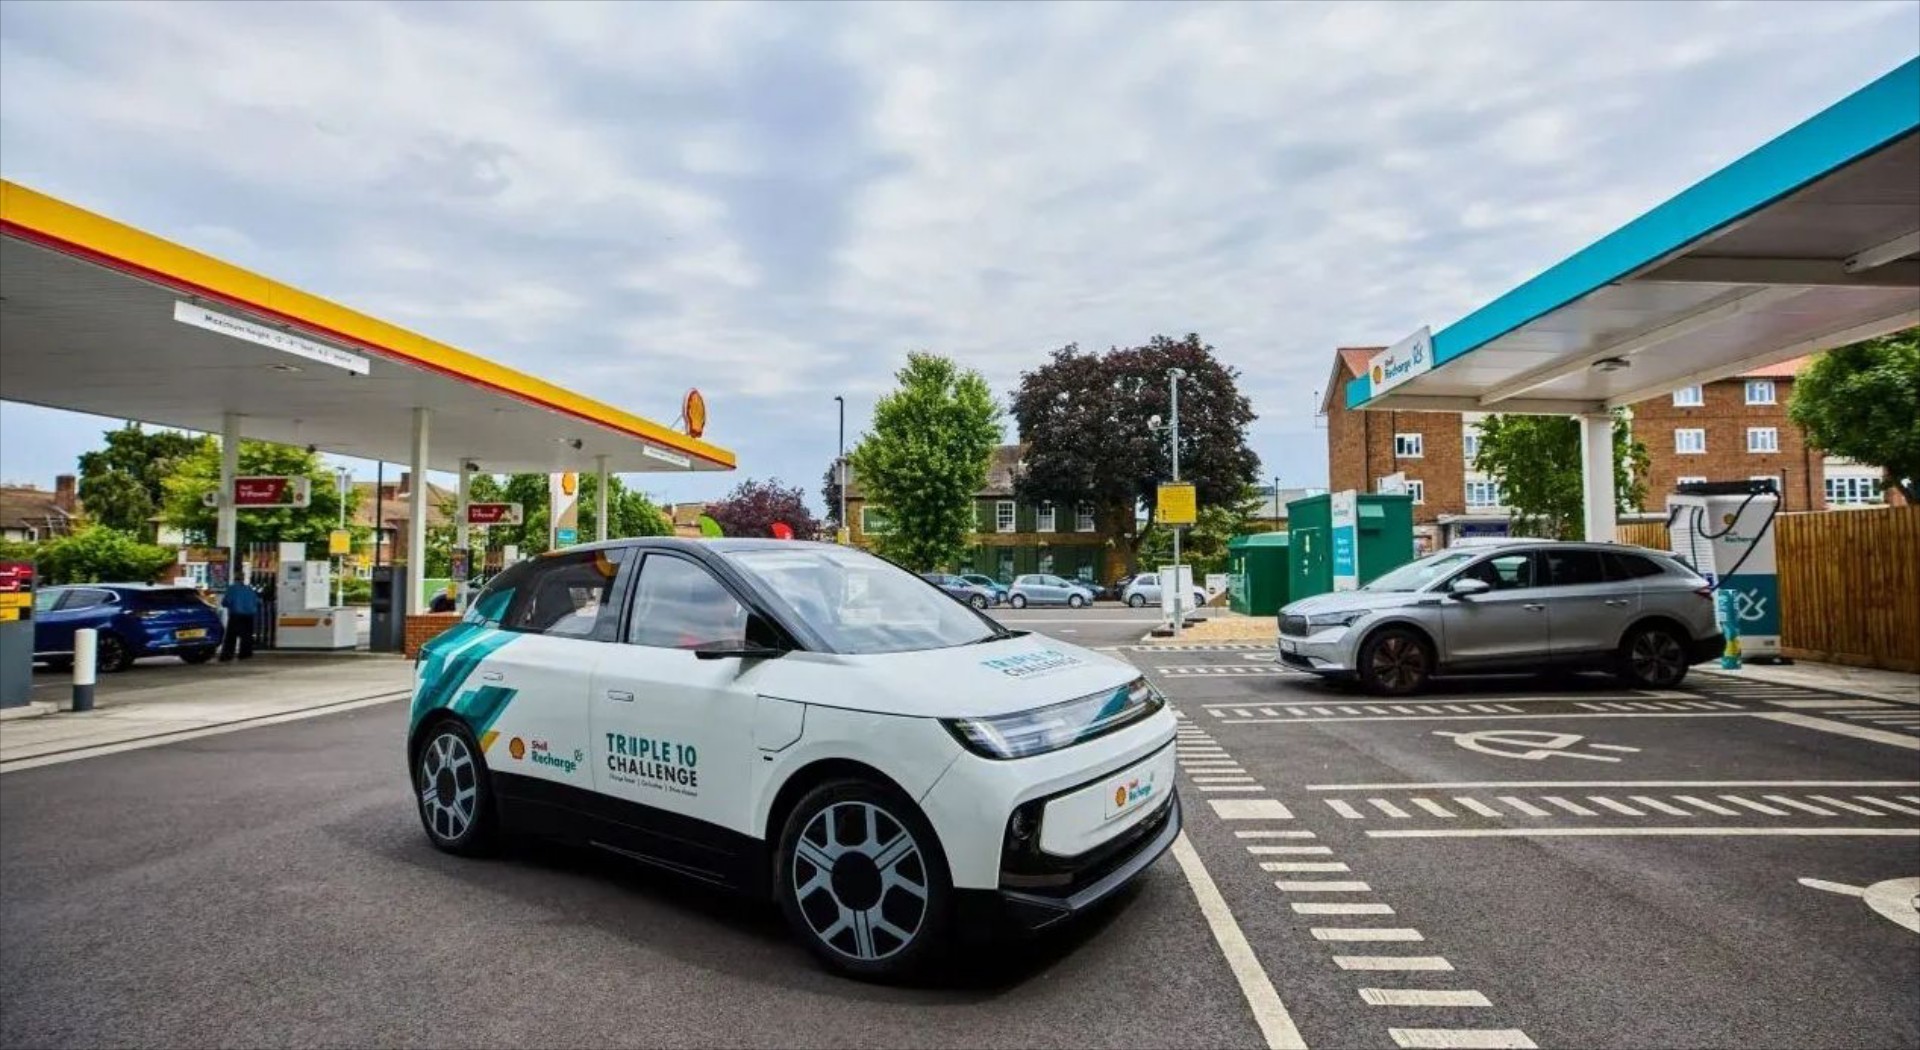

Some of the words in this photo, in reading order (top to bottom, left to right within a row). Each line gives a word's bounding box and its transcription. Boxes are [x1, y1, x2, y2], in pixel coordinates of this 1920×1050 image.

[1384, 359, 1411, 379] Recharge
[531, 740, 548, 751] Shell
[676, 744, 697, 768] 10
[531, 750, 577, 773] Recharge
[607, 755, 698, 787] CHALLENGE
